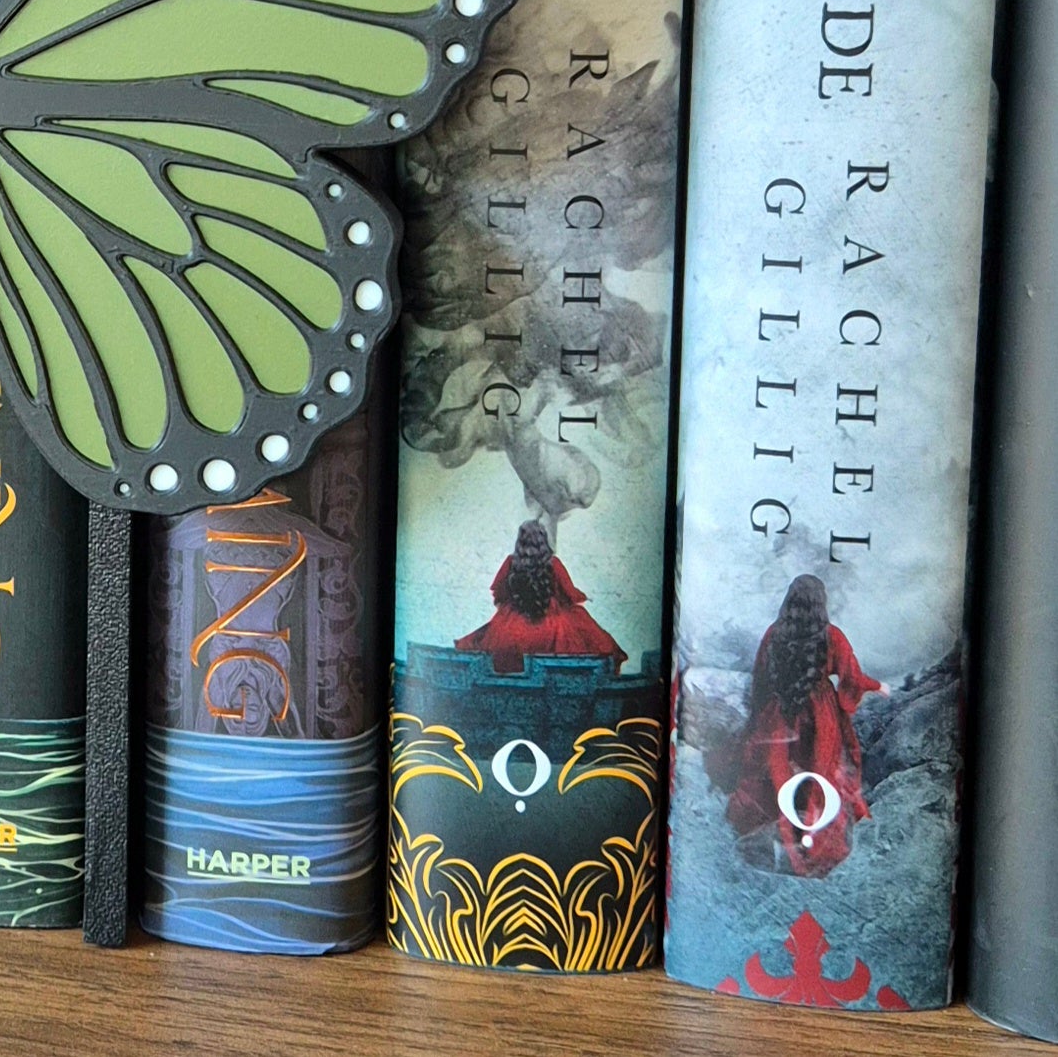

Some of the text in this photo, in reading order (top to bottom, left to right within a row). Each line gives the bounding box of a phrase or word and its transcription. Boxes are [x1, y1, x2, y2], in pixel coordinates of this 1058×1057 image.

[480, 67, 531, 421] GILLIG
[557, 48, 610, 443] RACHEL
[749, 177, 807, 538] GILLIG
[829, 159, 890, 564] RACHEL
[186, 846, 312, 880] HARPER
